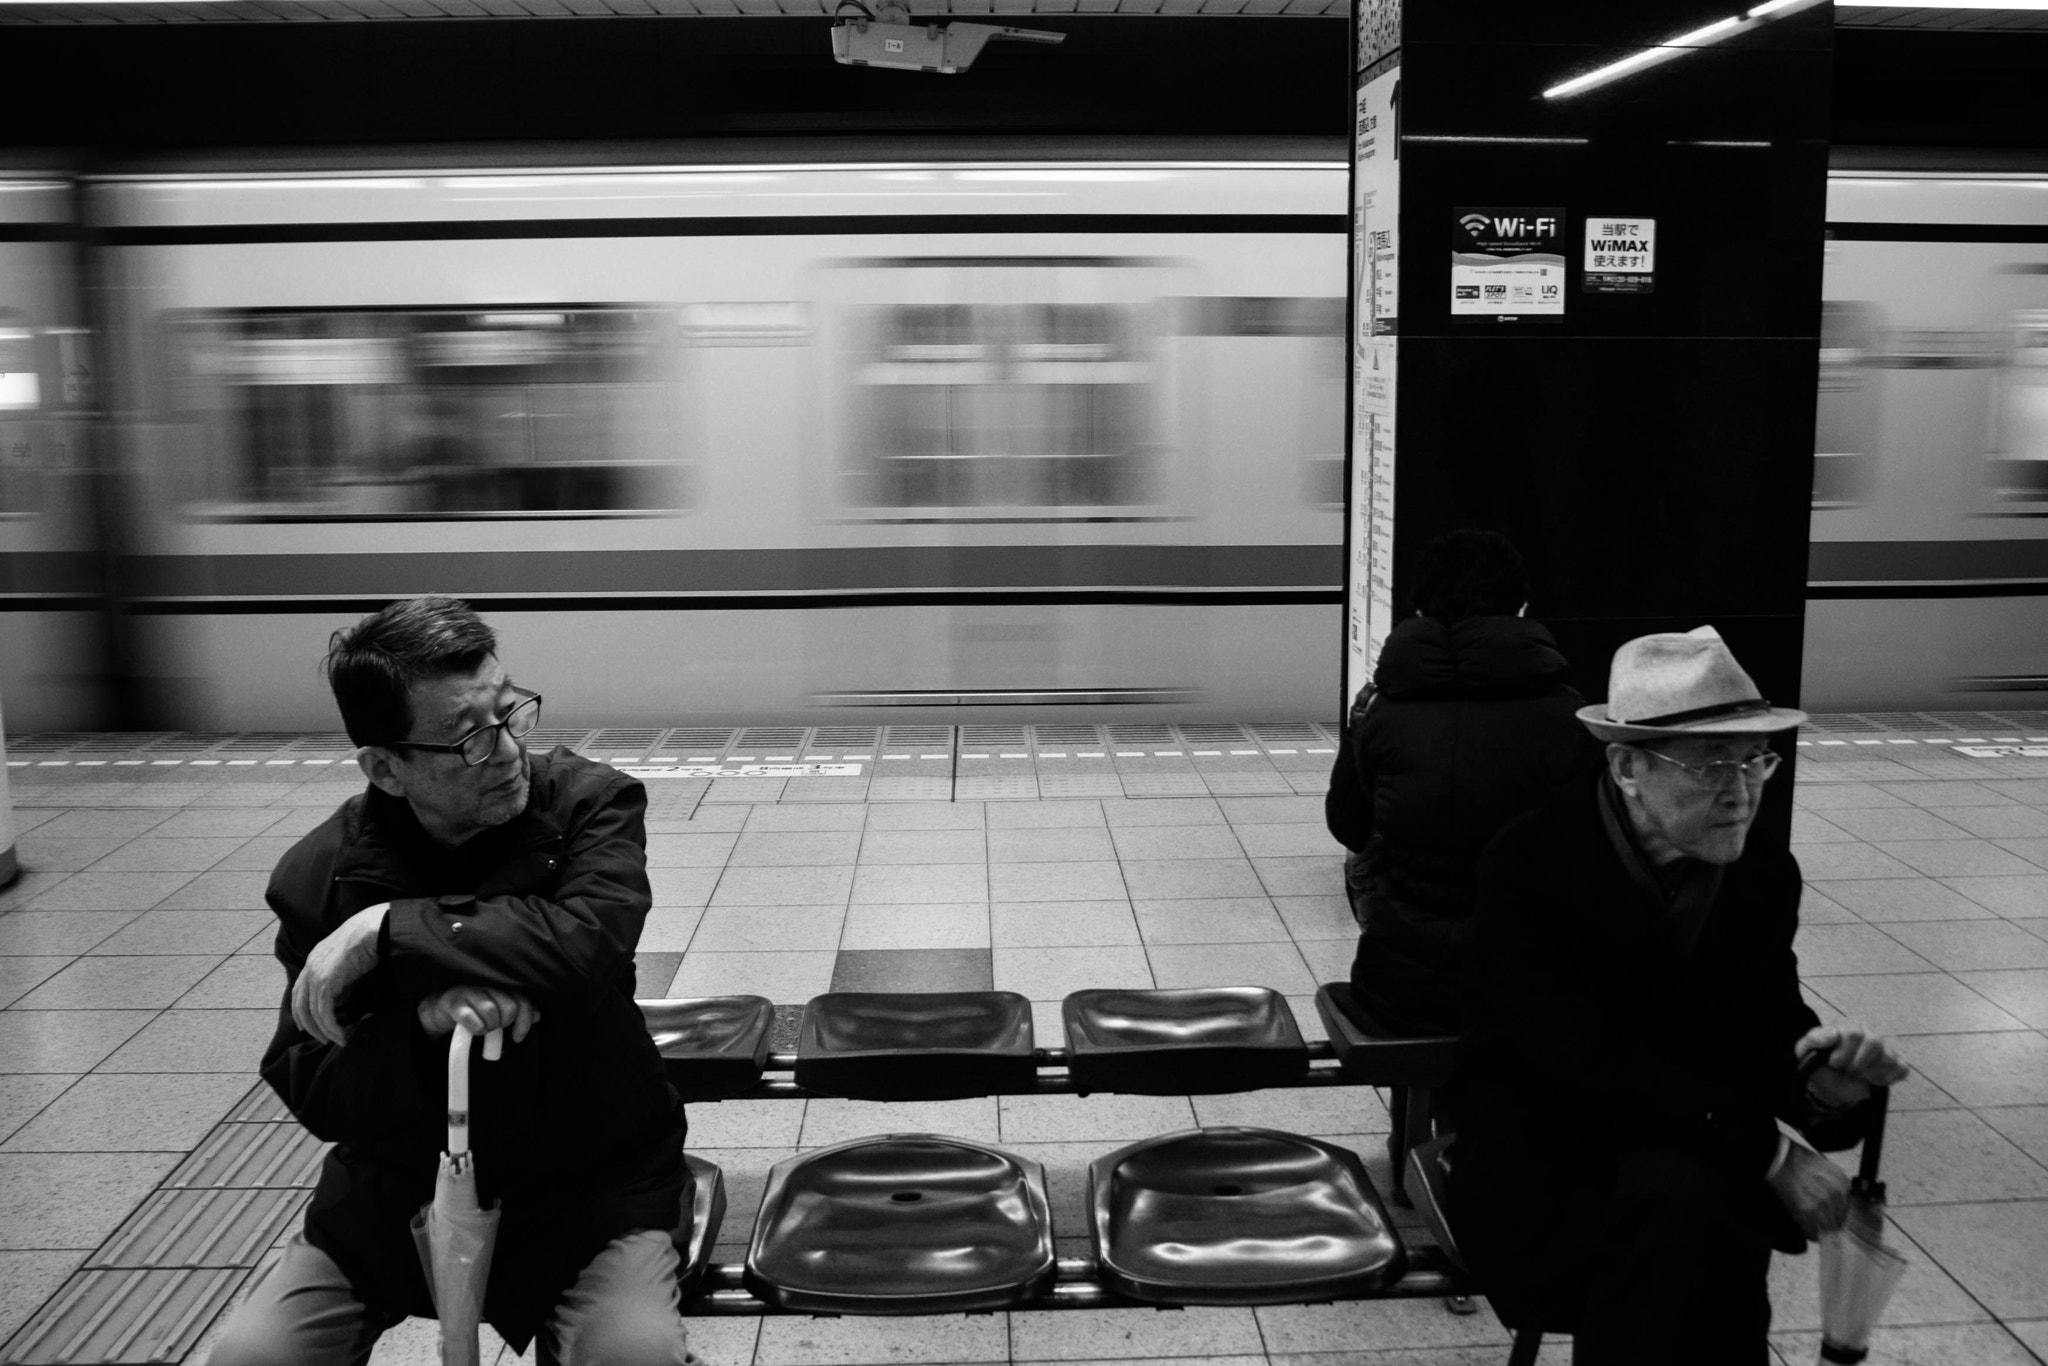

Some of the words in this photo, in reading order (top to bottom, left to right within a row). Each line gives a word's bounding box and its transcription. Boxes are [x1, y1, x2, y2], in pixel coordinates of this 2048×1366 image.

[1493, 217, 1556, 238] Wi-Fi
[1601, 223, 1640, 236] 当駅で
[1591, 239, 1648, 252] WiMAX
[1594, 255, 1645, 268] 使えます!
